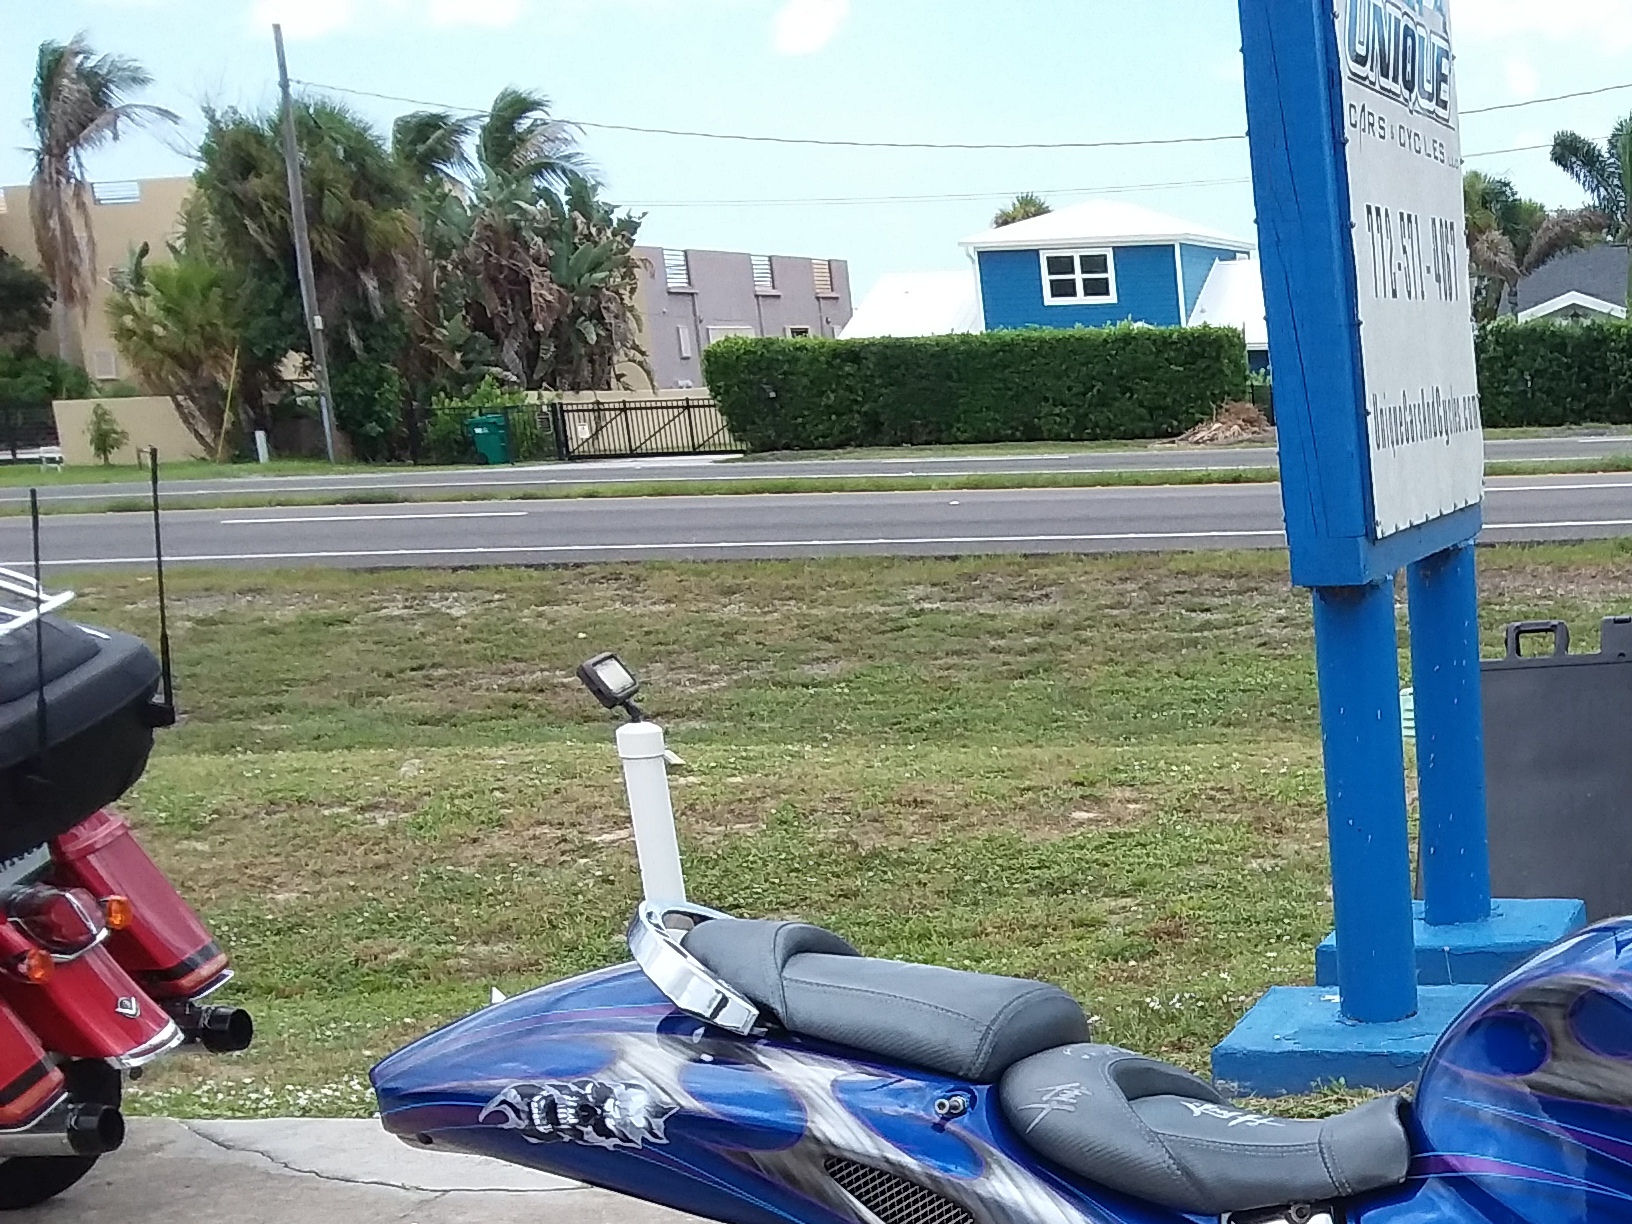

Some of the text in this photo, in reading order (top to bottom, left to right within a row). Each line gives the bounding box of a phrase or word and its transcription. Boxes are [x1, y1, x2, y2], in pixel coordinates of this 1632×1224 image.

[1345, 0, 1451, 120] UNIQUE
[1348, 102, 1387, 152] CARS
[1398, 123, 1446, 165] CYCLES
